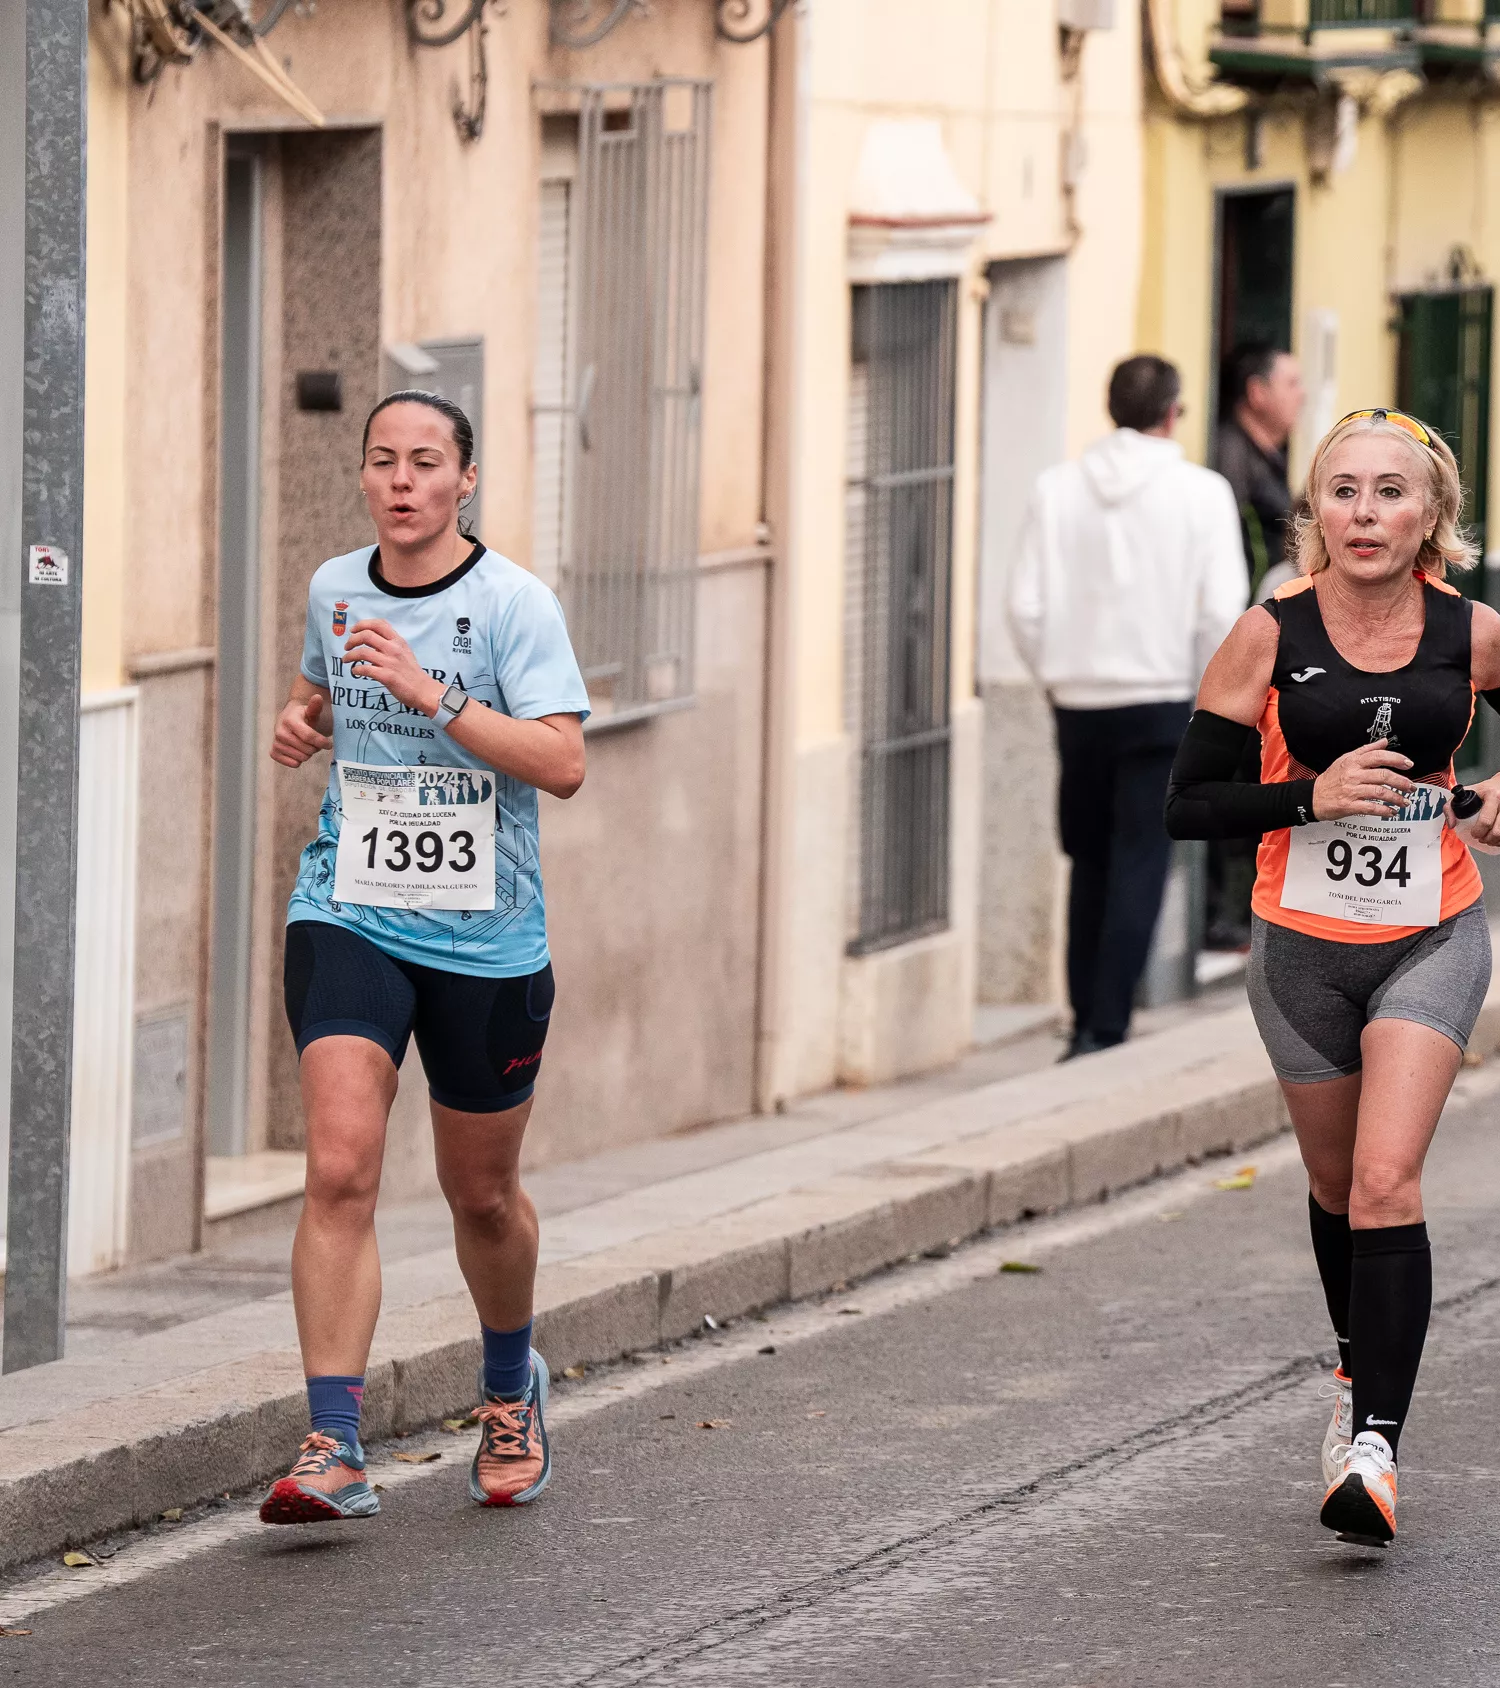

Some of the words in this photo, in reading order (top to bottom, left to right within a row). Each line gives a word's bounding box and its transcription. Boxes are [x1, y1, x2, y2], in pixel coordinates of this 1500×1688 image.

[1360, 696, 1402, 704] ATLETISMO
[346, 718, 366, 730] LOS
[368, 722, 435, 740] CORRALES
[368, 770, 405, 780] PROVINCIAL
[406, 772, 416, 780] DE
[417, 771, 460, 788] 2024
[377, 778, 416, 787] POPULARES
[1360, 825, 1382, 833] CIUDAD
[361, 826, 476, 873] 1393
[1325, 839, 1411, 888] 934
[375, 881, 405, 889] DOLORES
[1328, 891, 1344, 900] TOÑI
[1345, 894, 1358, 902] DEL
[1359, 896, 1375, 904] PINO
[1376, 898, 1402, 906] GARCÍA
